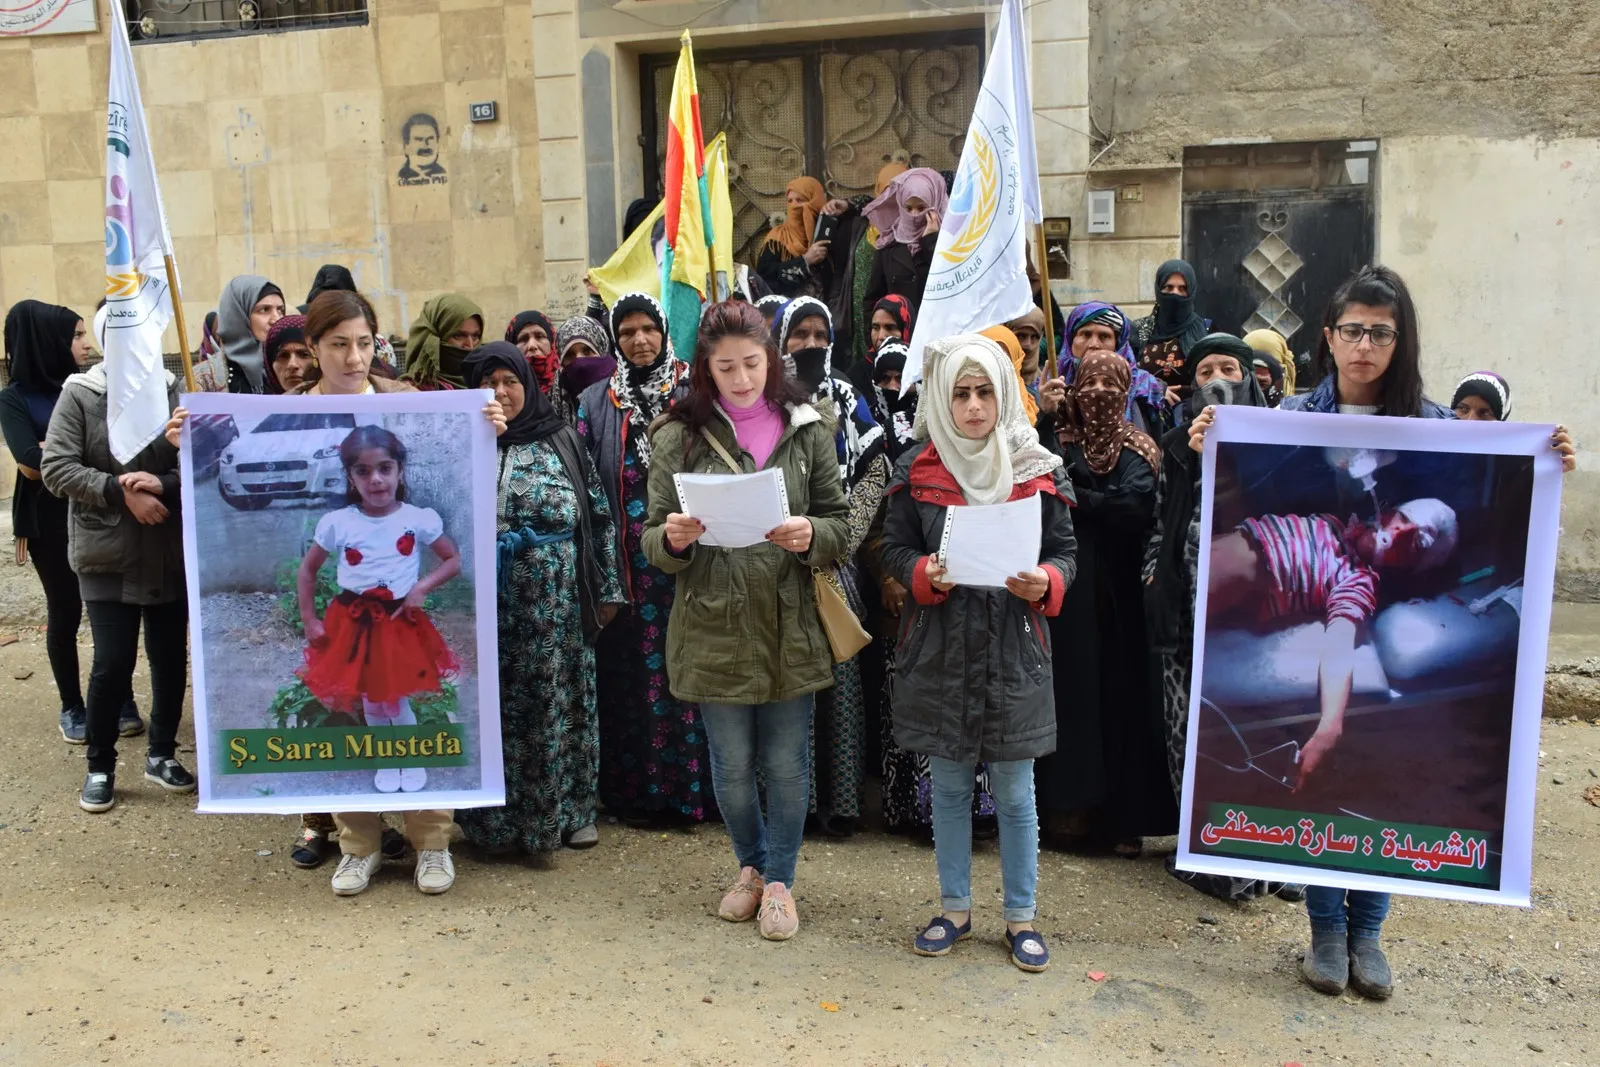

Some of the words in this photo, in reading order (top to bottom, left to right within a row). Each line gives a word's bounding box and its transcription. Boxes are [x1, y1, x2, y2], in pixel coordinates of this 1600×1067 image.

[473, 105, 491, 117] 16
[230, 736, 257, 768] Ş.
[266, 735, 335, 762] Sara
[344, 731, 462, 760] Mustefa
[1200, 808, 1297, 846] مصطفى
[1297, 818, 1358, 857] سارة
[1380, 826, 1488, 872] الشهيدة
